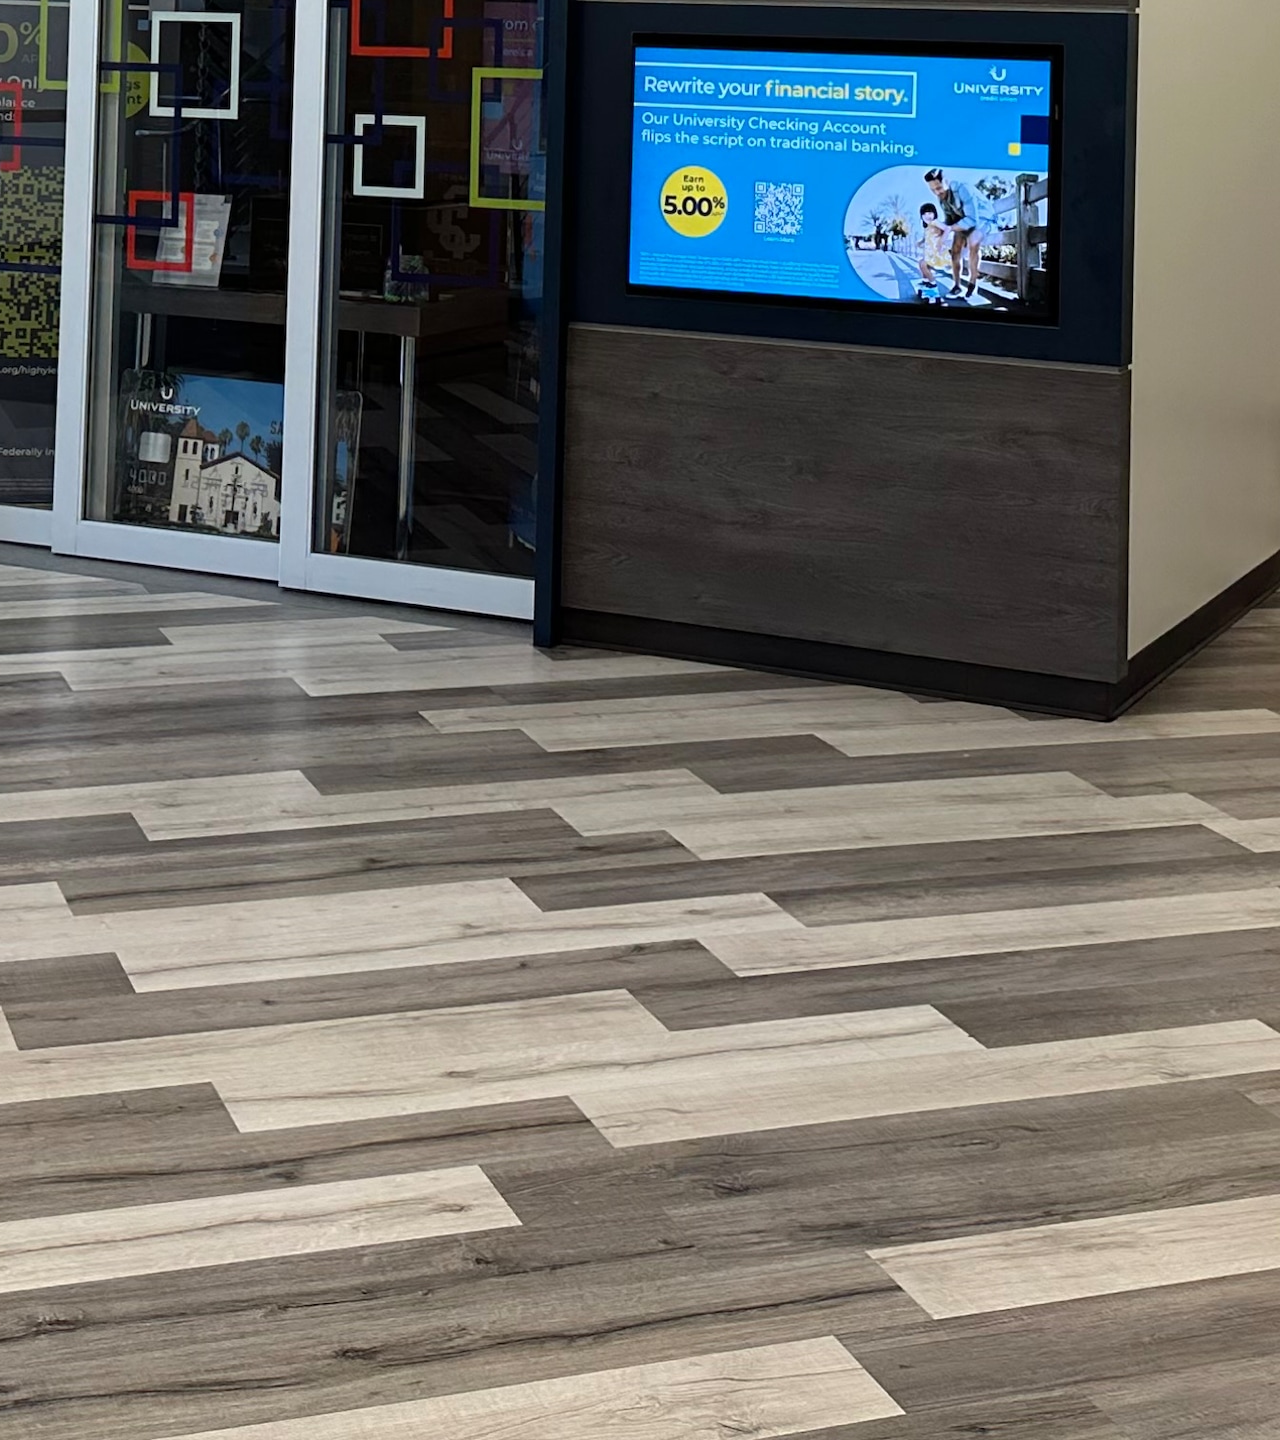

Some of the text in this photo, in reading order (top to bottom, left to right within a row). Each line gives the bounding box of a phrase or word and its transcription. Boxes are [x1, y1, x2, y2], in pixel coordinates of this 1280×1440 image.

[644, 75, 909, 105] Rewrite your financial story.
[954, 82, 1044, 96] UNIVERSITY
[641, 112, 886, 136] Our University Checking Account
[641, 131, 919, 157] flips the script on traditional banking.
[683, 175, 704, 183] Earn
[663, 195, 725, 217] 5.00%
[130, 399, 201, 415] UNIVERSITY
